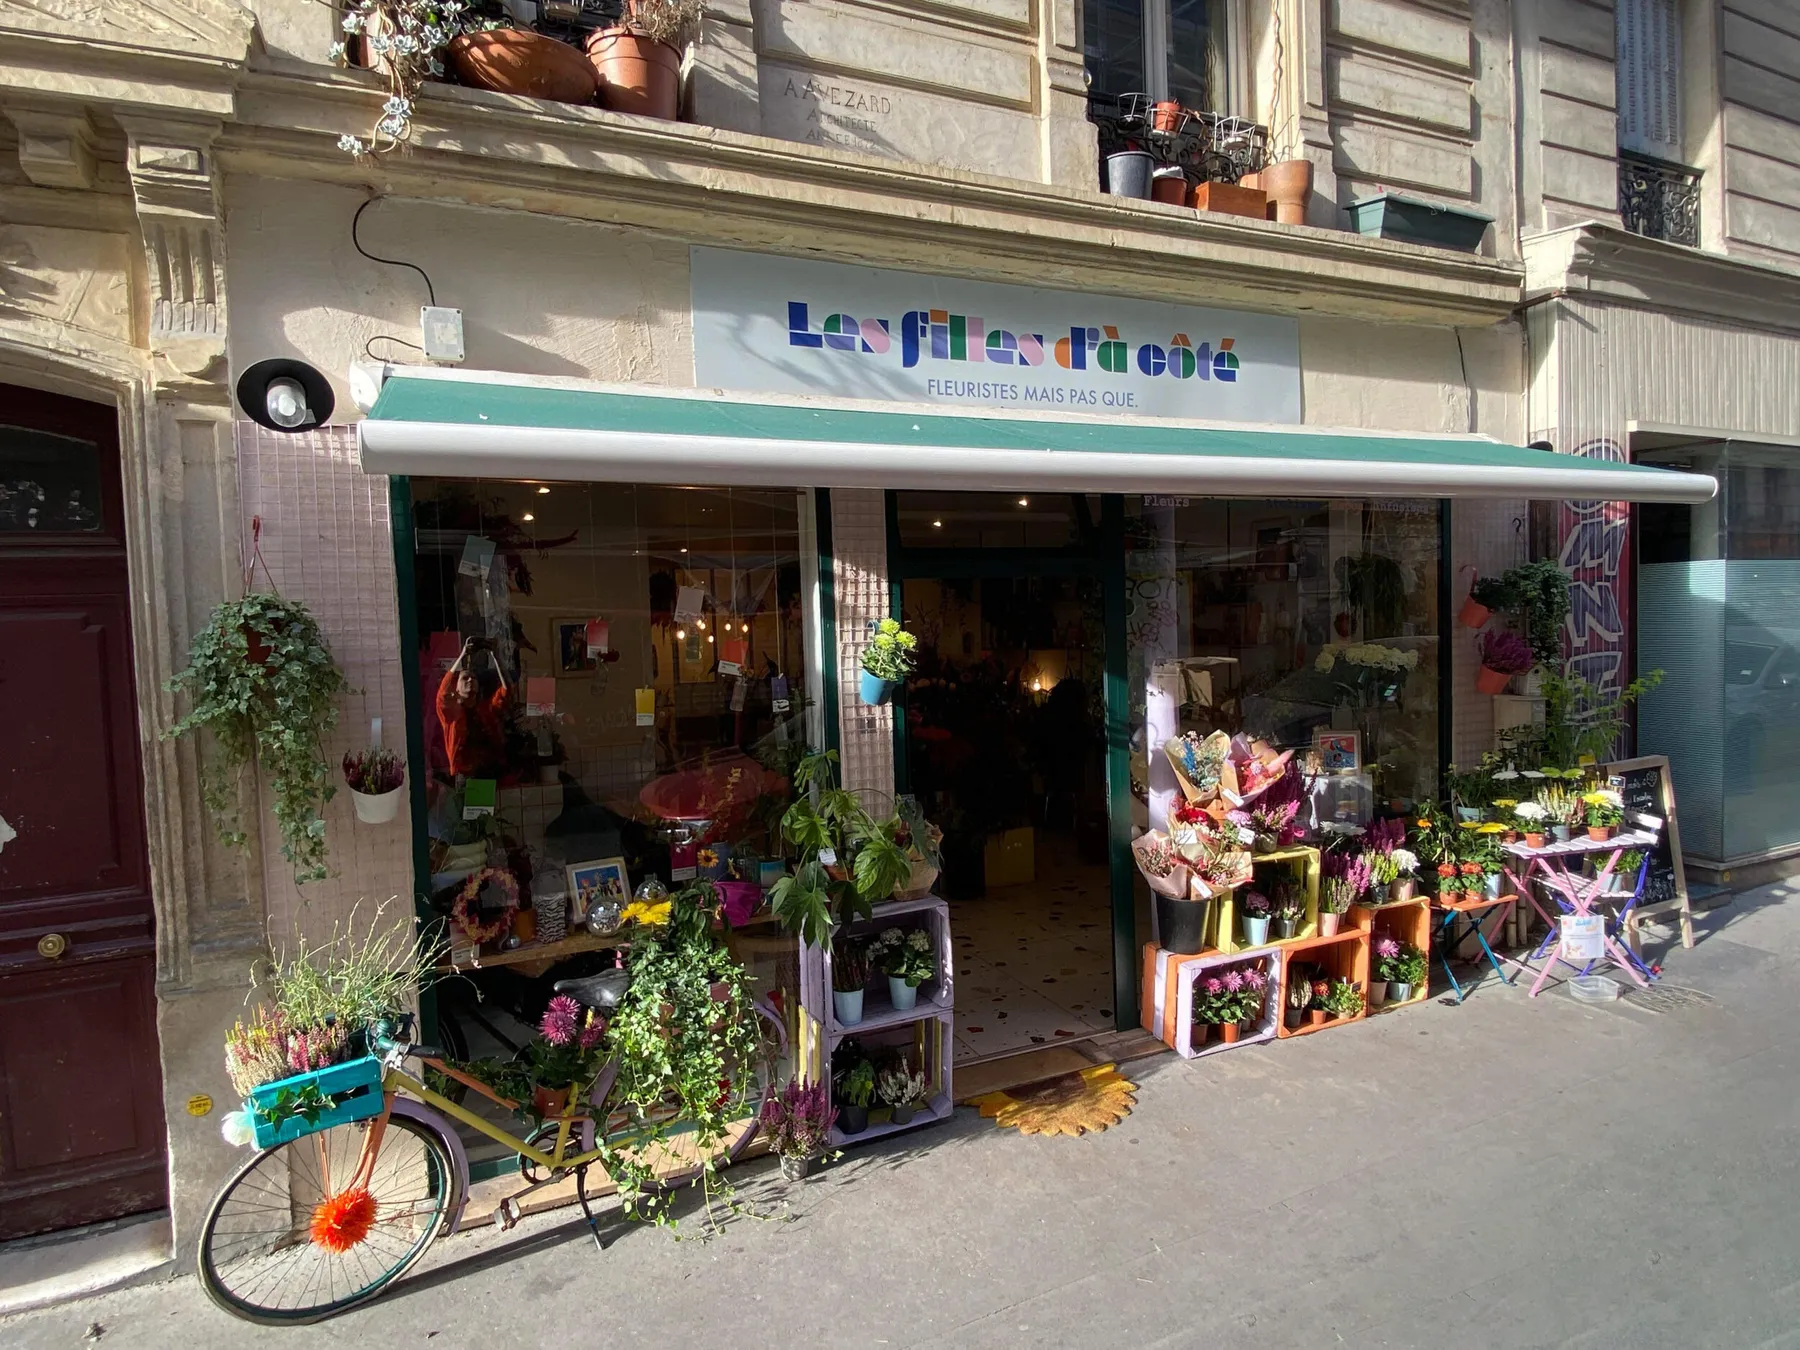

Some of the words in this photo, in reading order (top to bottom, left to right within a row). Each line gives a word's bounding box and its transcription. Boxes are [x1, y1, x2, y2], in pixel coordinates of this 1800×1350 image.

[788, 301, 891, 354] Les
[901, 309, 1045, 369] filles
[1054, 325, 1128, 374] d'à
[1137, 333, 1240, 382] côté
[928, 379, 1019, 400] FLEURISTES
[1024, 385, 1064, 403] MAIS
[1070, 388, 1097, 406] PAS
[1102, 391, 1139, 408] QUE.
[1143, 494, 1190, 508] Fleurs
